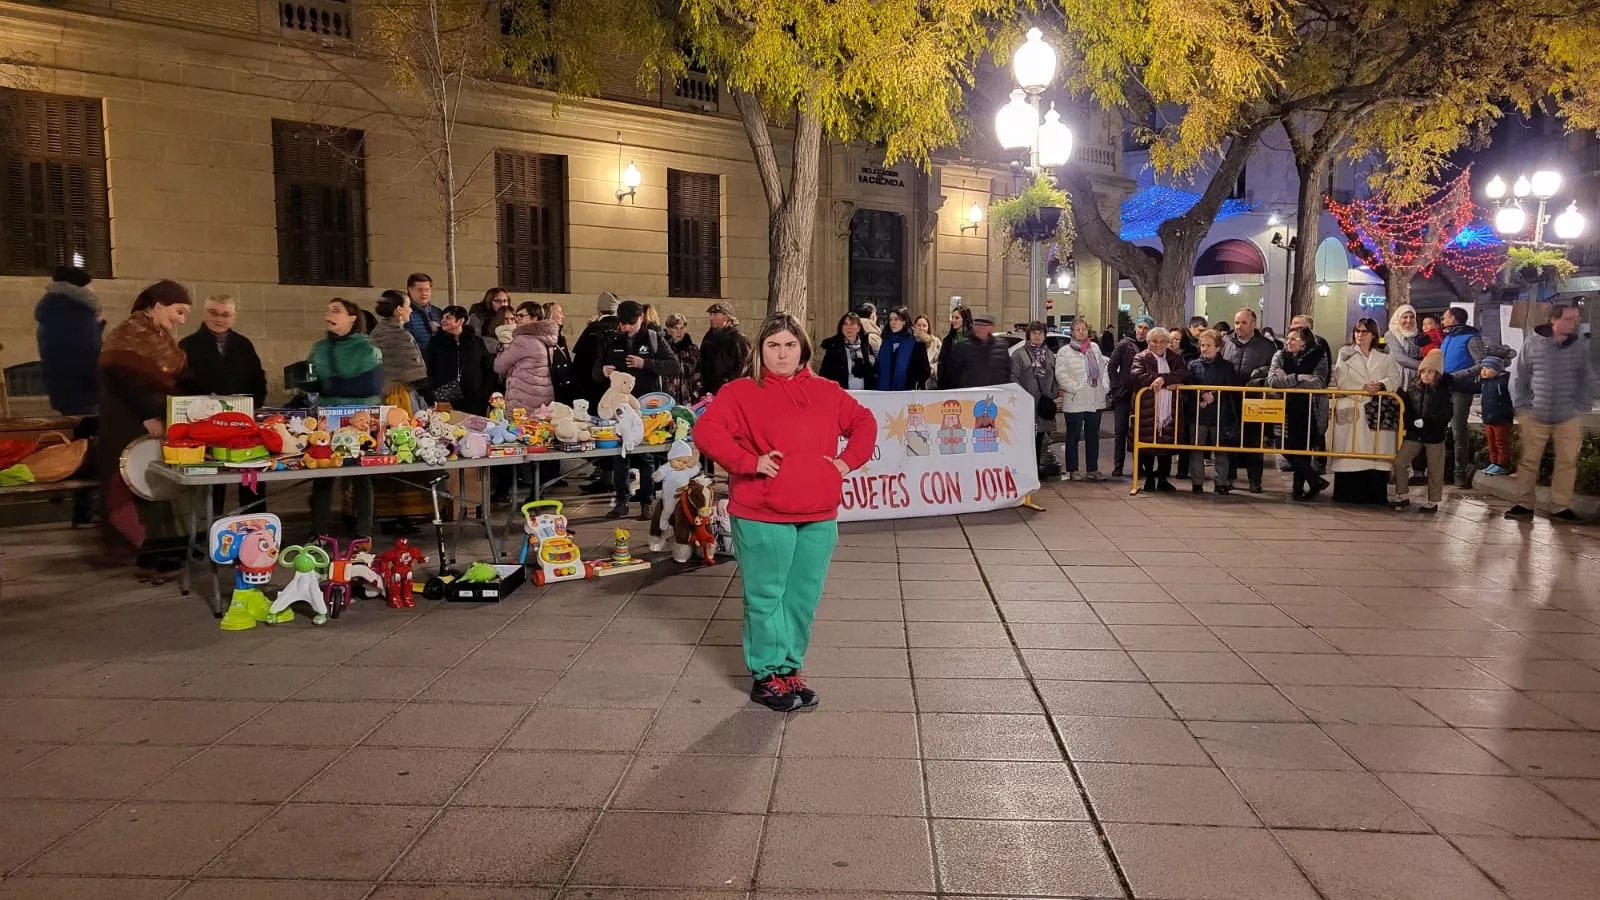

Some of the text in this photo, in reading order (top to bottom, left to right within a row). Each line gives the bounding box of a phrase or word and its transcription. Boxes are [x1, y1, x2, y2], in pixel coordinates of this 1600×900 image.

[841, 465, 1018, 510] GUETES CON JOTA
